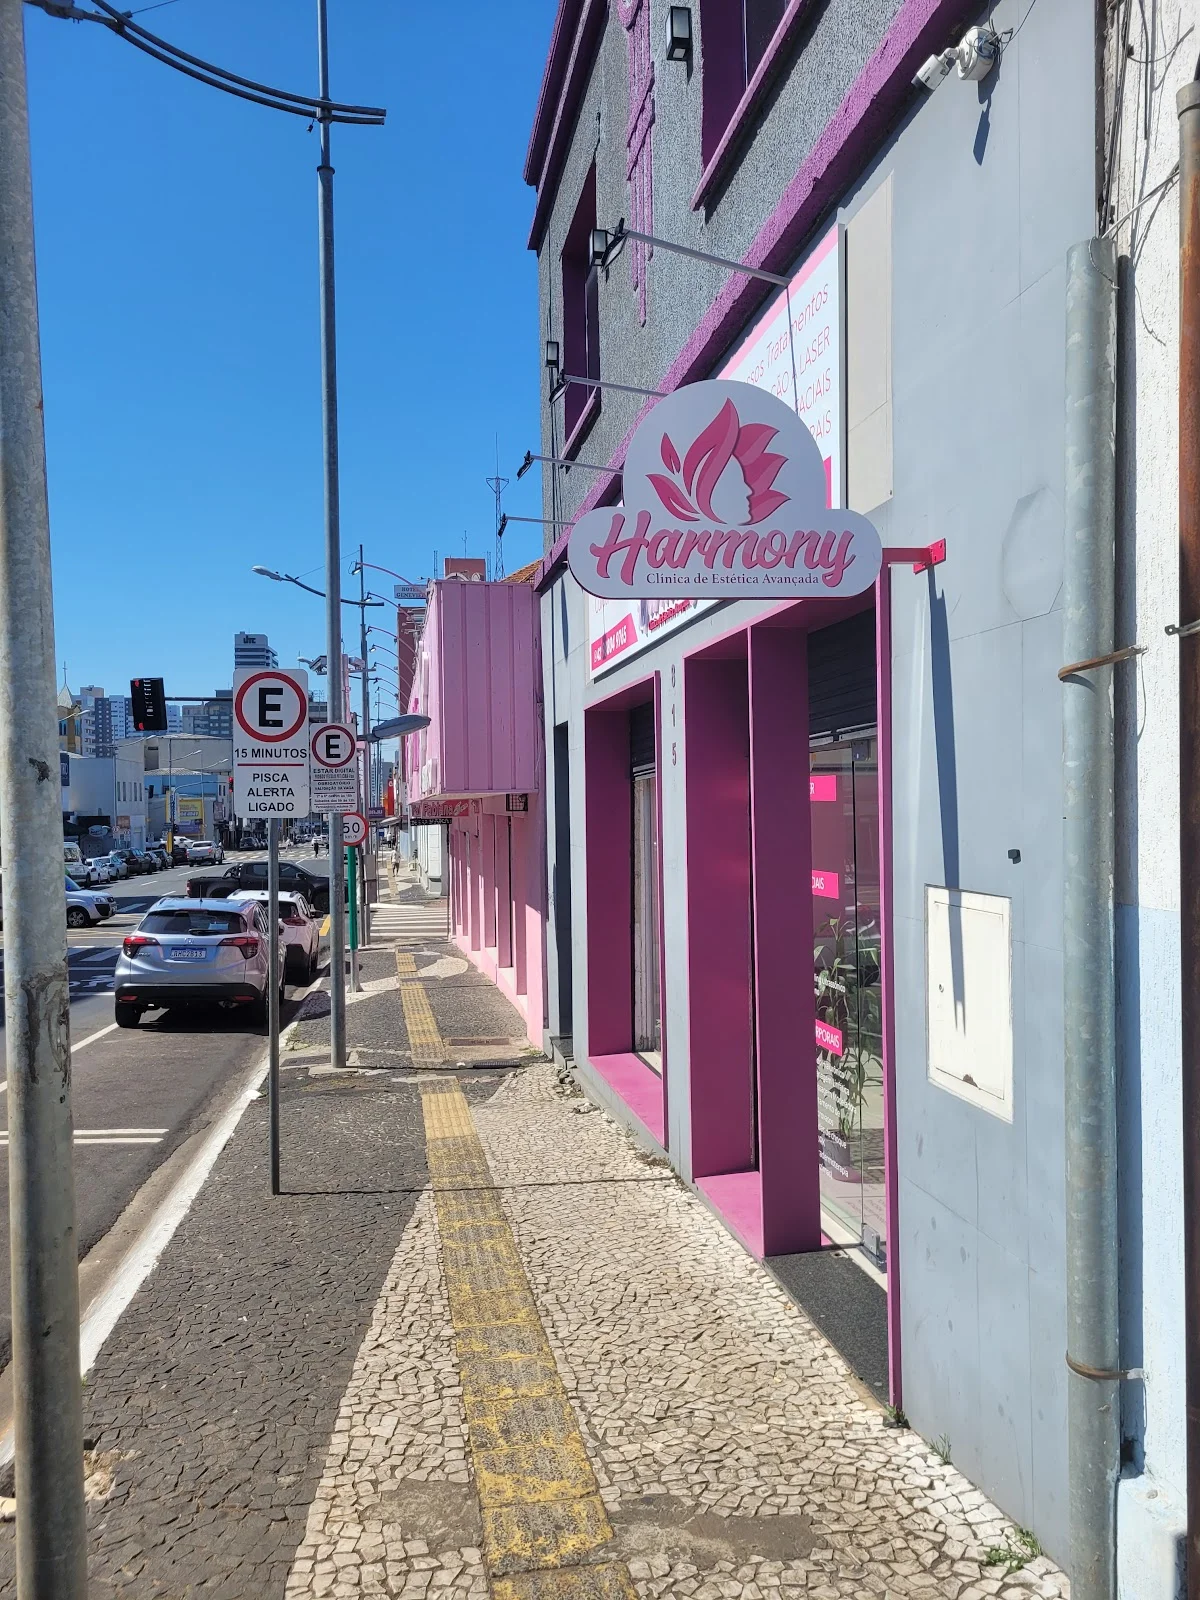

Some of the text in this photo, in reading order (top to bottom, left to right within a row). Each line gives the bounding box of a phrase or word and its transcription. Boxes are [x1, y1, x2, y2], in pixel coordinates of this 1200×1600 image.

[800, 325, 830, 375] LASER
[796, 367, 831, 419] ACIAIS
[589, 509, 856, 588] Harmony
[646, 572, 819, 587] Clínica de Estética Avançada
[258, 687, 284, 728] E
[234, 748, 307, 759] 15 MINUTOS
[325, 734, 341, 759] E
[252, 773, 289, 783] PISCA
[247, 787, 295, 797] ALERTA
[248, 802, 294, 812] LIGADO
[343, 822, 360, 834] 50
